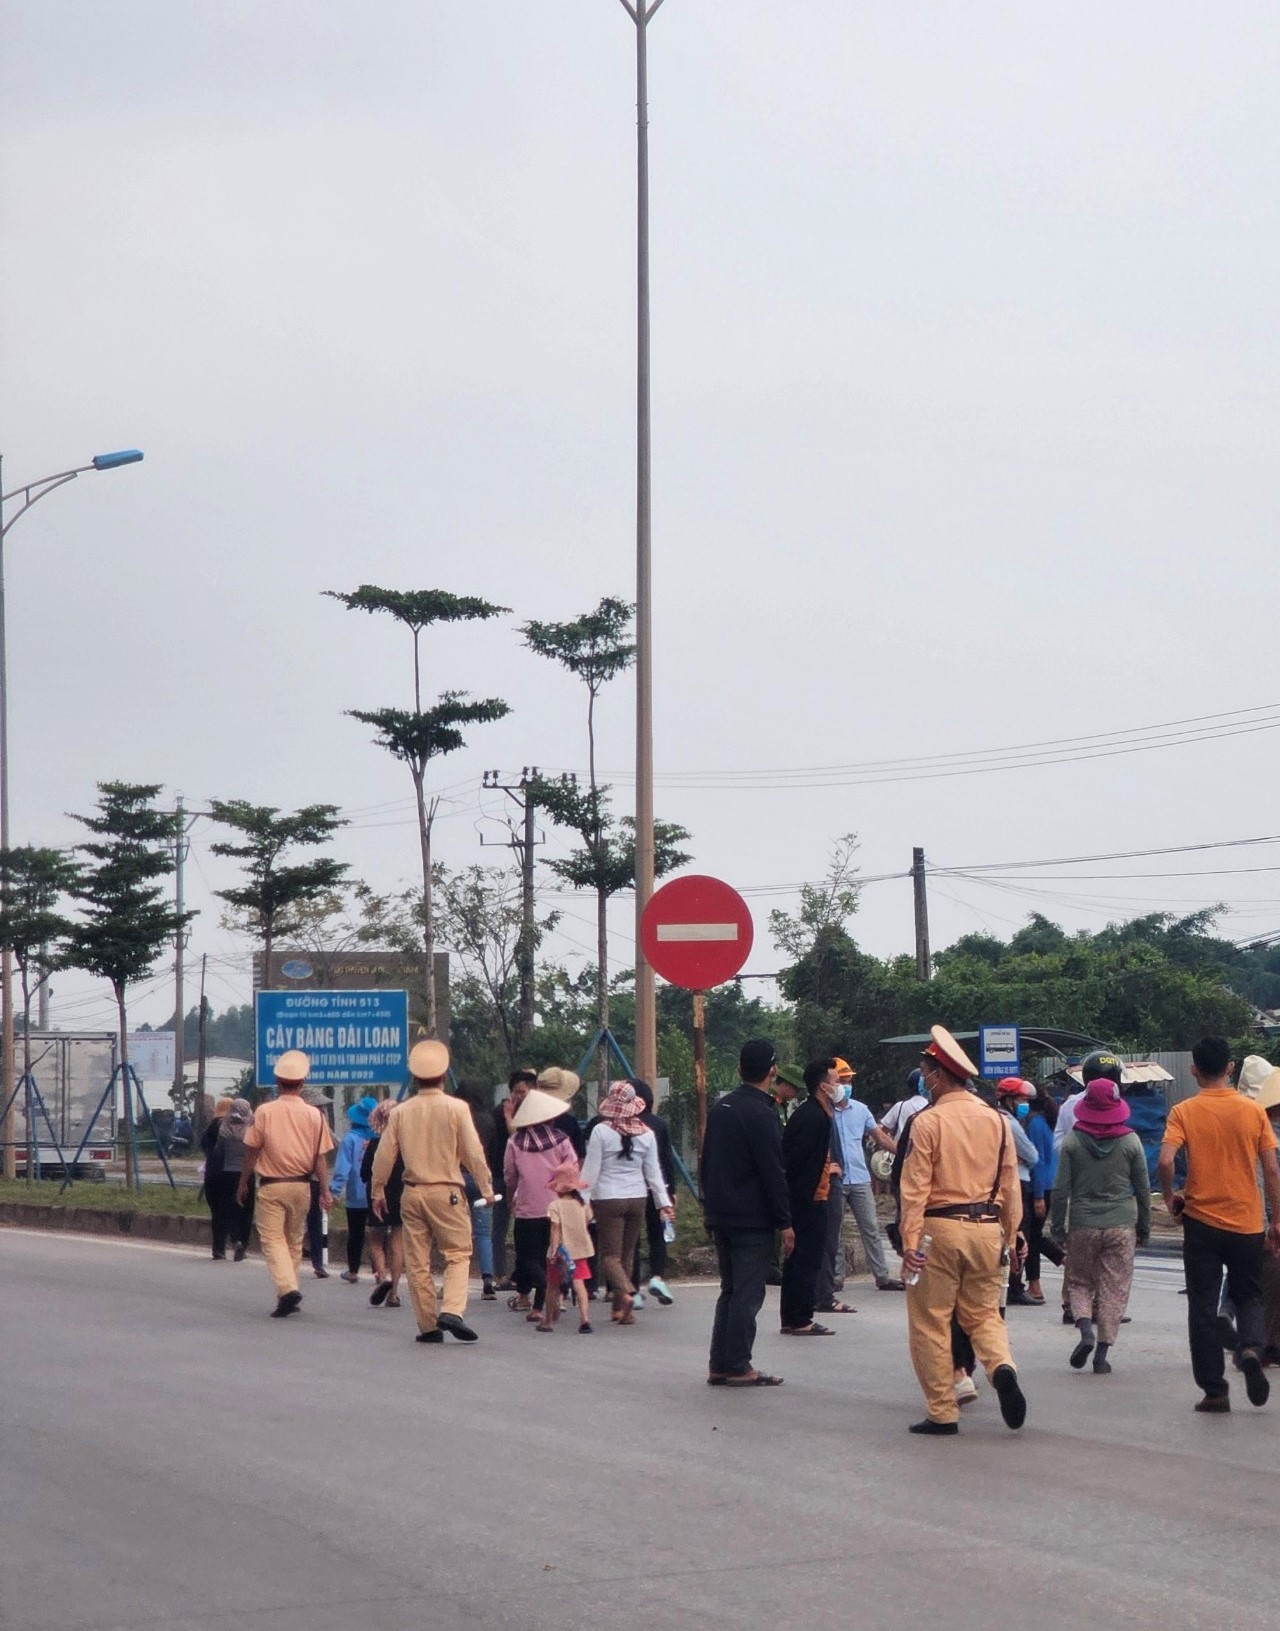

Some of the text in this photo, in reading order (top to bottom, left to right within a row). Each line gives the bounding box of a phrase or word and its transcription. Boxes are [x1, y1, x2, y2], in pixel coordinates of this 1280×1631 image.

[286, 995, 329, 1008] ĐƯỜNG
[360, 998, 380, 1008] 513
[266, 1023, 400, 1049] CÂY BÀNG ĐÀI LOAN
[351, 1070, 374, 1080] 2022
